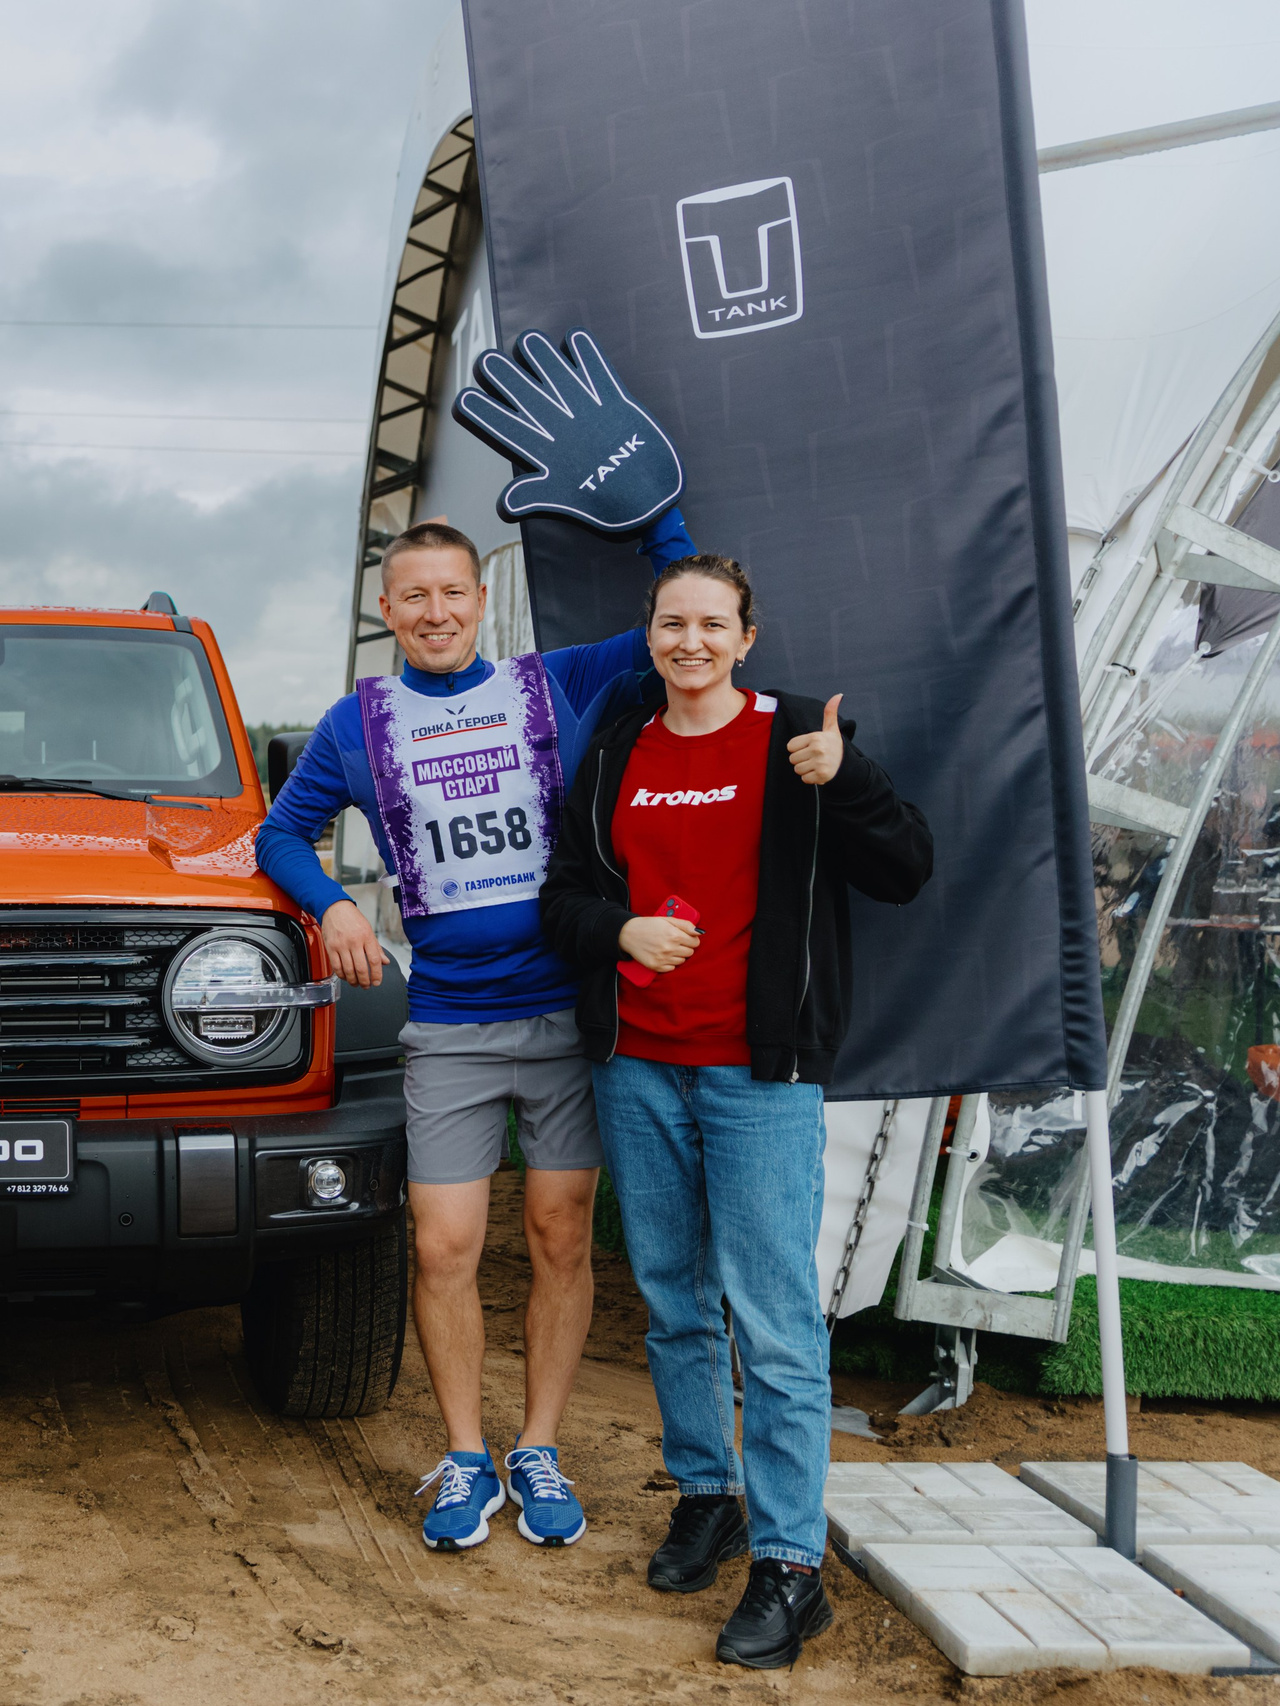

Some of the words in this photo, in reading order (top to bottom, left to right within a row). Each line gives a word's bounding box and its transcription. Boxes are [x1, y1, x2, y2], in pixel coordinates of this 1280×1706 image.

[707, 295, 788, 322] TANK
[578, 433, 646, 492] TANK
[411, 722, 454, 739] ГОНКА
[457, 712, 507, 731] ГЕРОЕВ
[416, 744, 516, 782] МАССОВЫЙ
[444, 773, 496, 799] СТАРТ
[630, 785, 738, 807] kronos
[425, 806, 532, 864] 1658
[465, 872, 536, 892] ГАЗПРОМБАНК
[6, 1185, 16, 1193] +7
[17, 1185, 31, 1193] 812
[32, 1184, 47, 1193] 329
[48, 1184, 58, 1193] 76
[58, 1184, 69, 1193] 66
